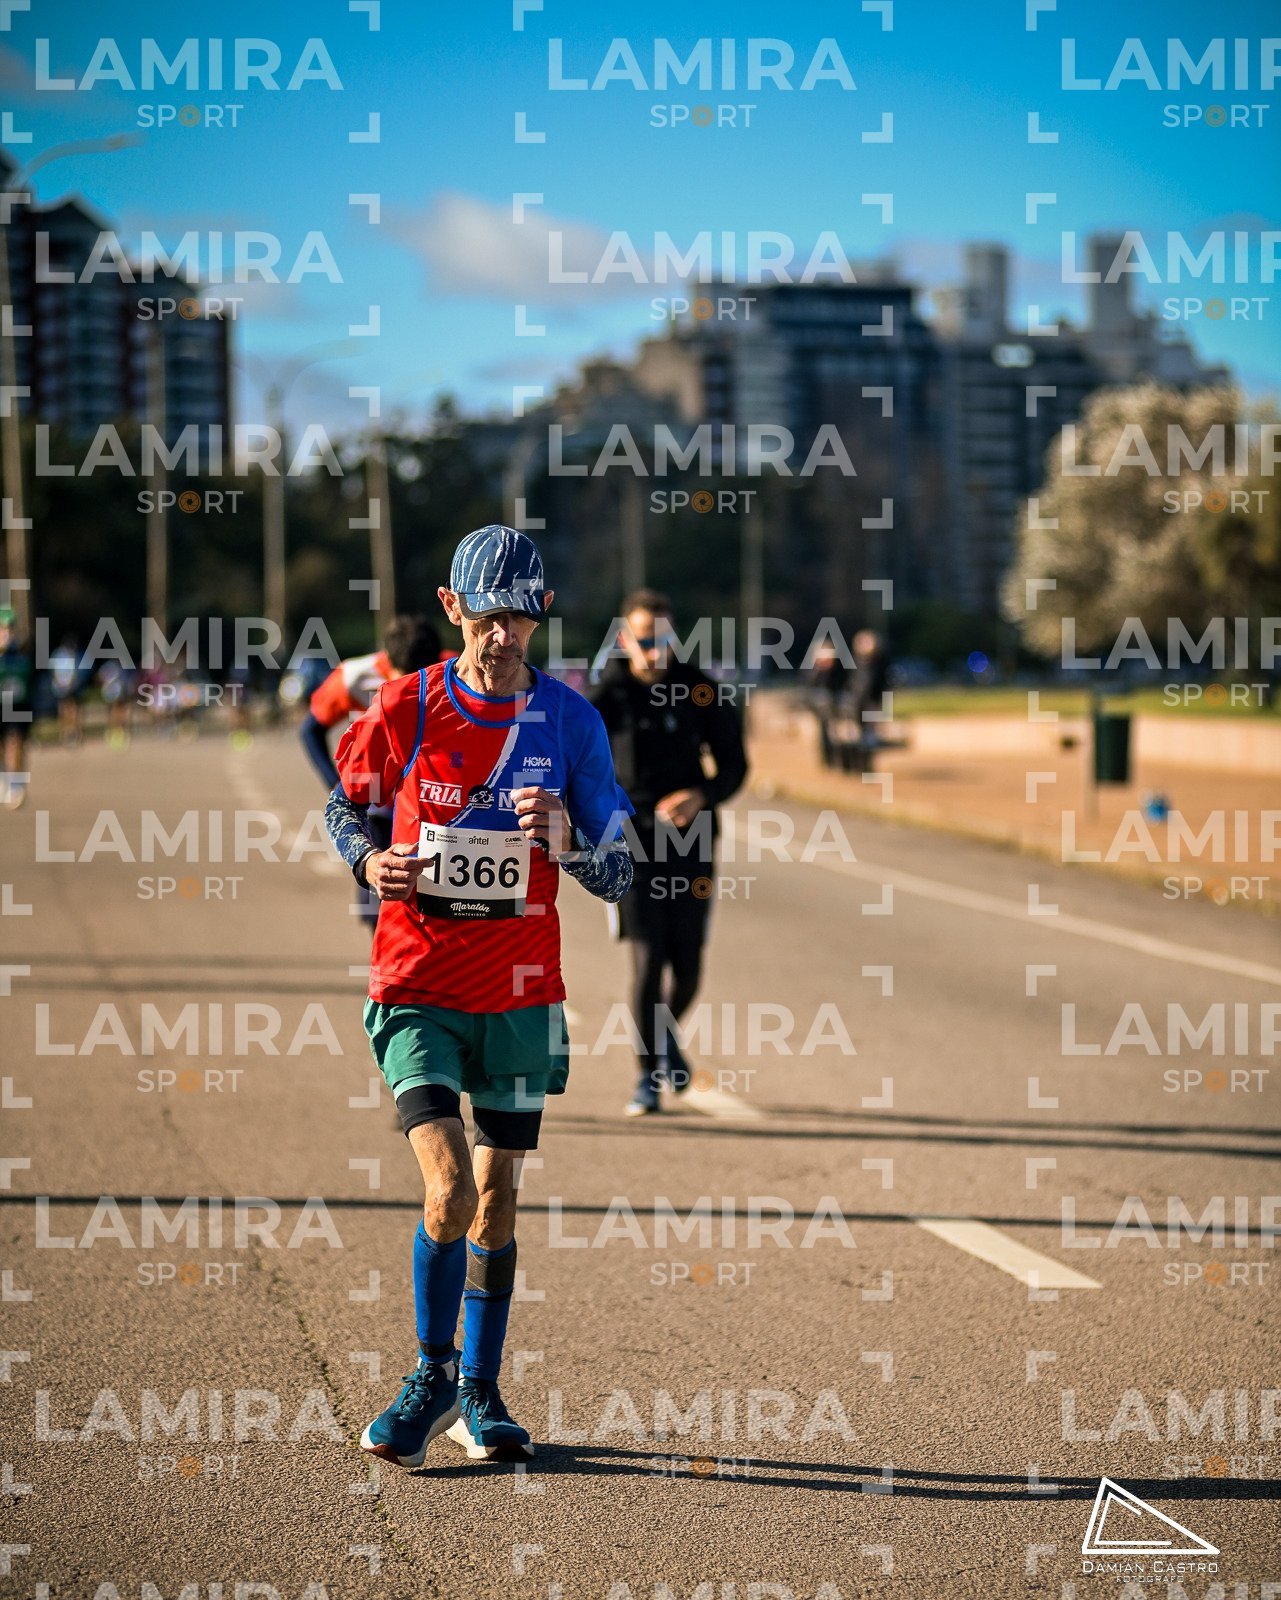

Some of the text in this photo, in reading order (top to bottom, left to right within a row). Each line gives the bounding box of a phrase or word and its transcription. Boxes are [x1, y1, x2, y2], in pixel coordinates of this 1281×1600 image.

[523, 756, 552, 768] HOKA
[420, 783, 461, 804] TRIA
[468, 836, 489, 845] antel
[432, 852, 520, 889] 1366
